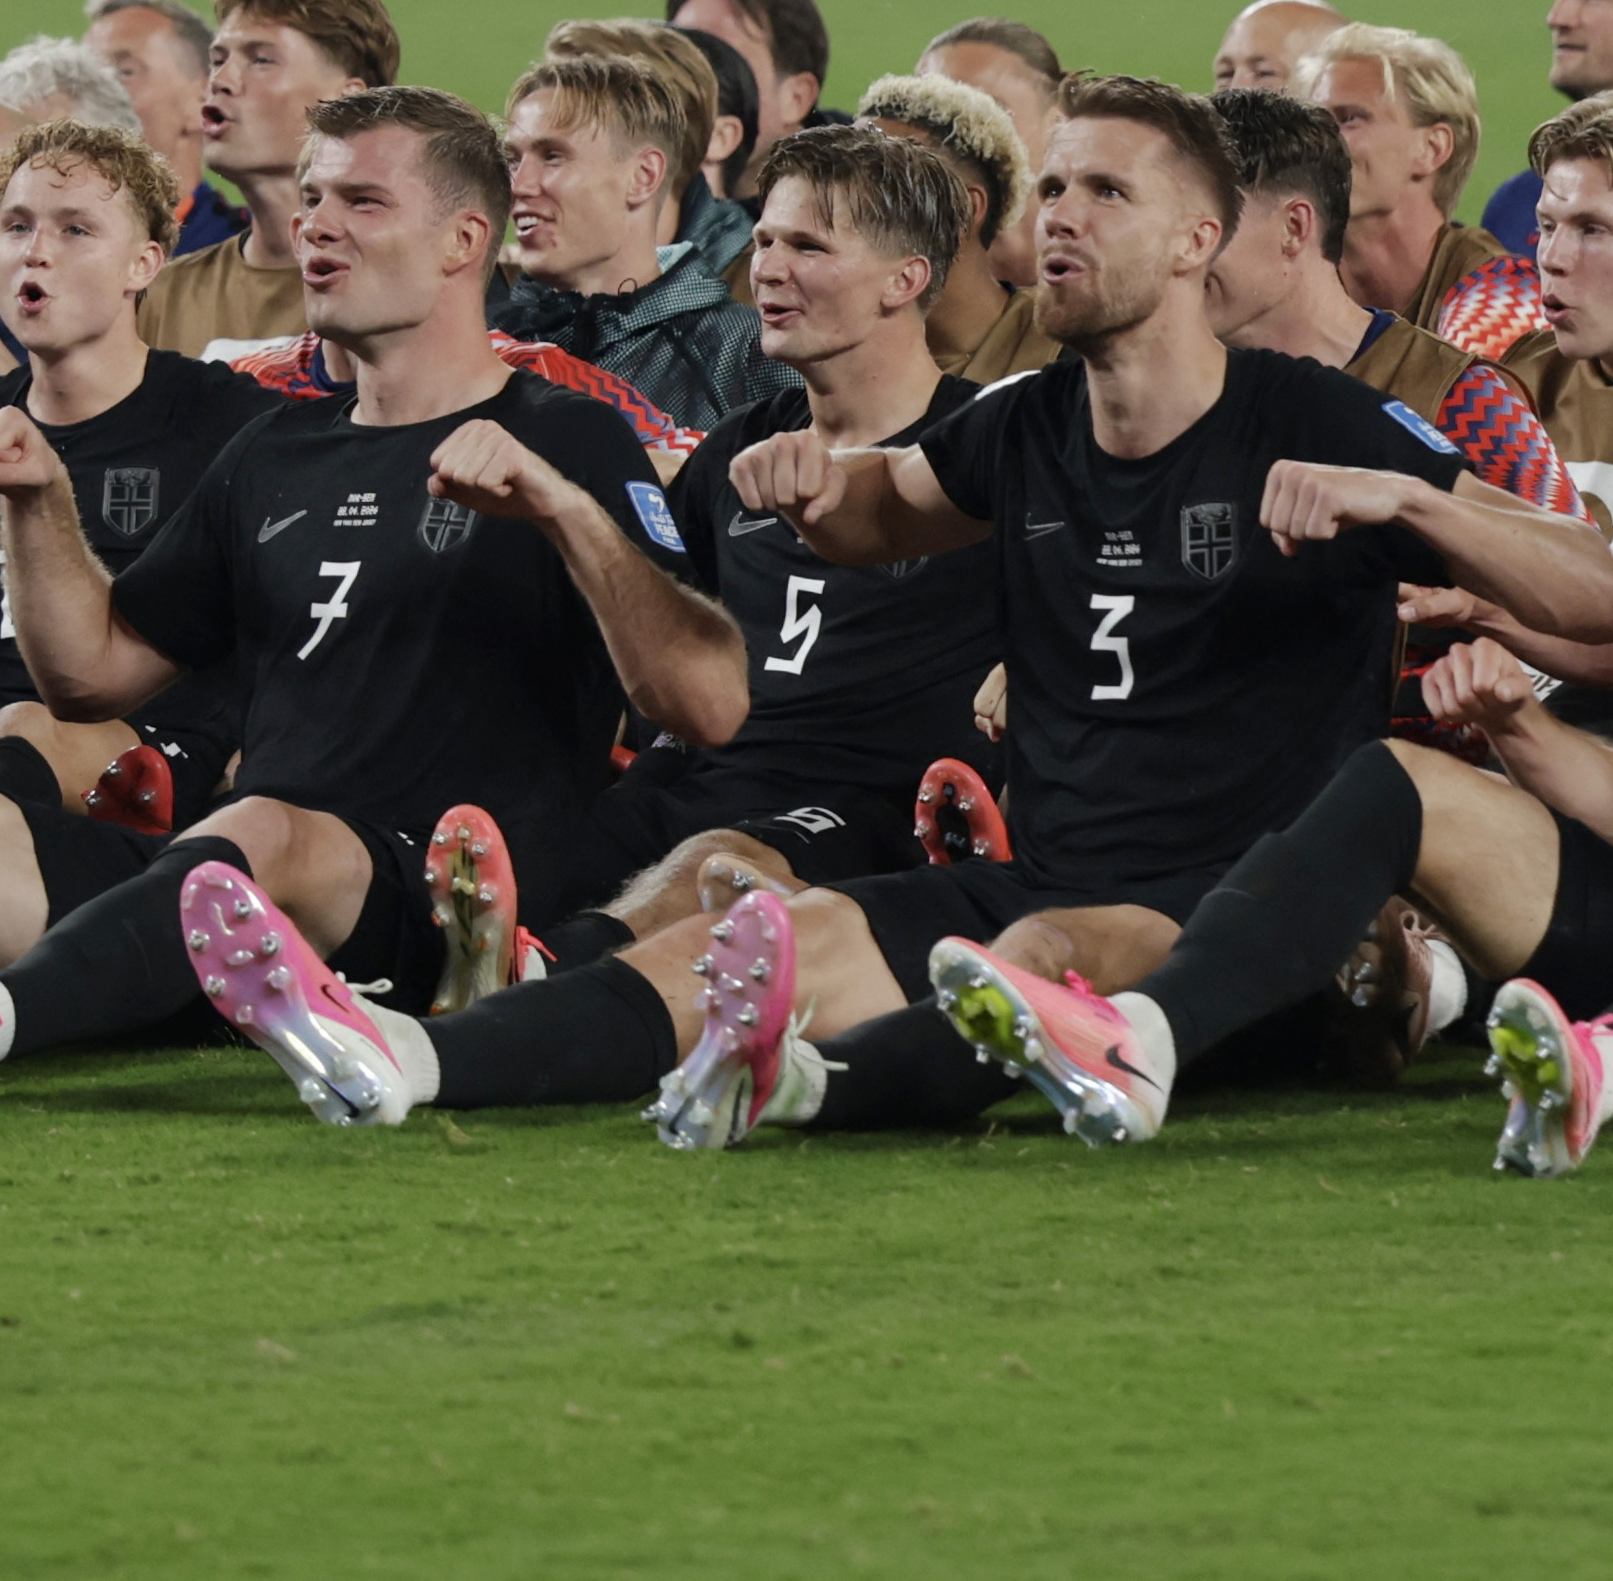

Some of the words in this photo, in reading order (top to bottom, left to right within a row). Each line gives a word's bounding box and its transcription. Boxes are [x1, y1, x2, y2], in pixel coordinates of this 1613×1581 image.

[297, 561, 362, 661] 7
[763, 575, 826, 676] 5
[1089, 593, 1135, 700] 3
